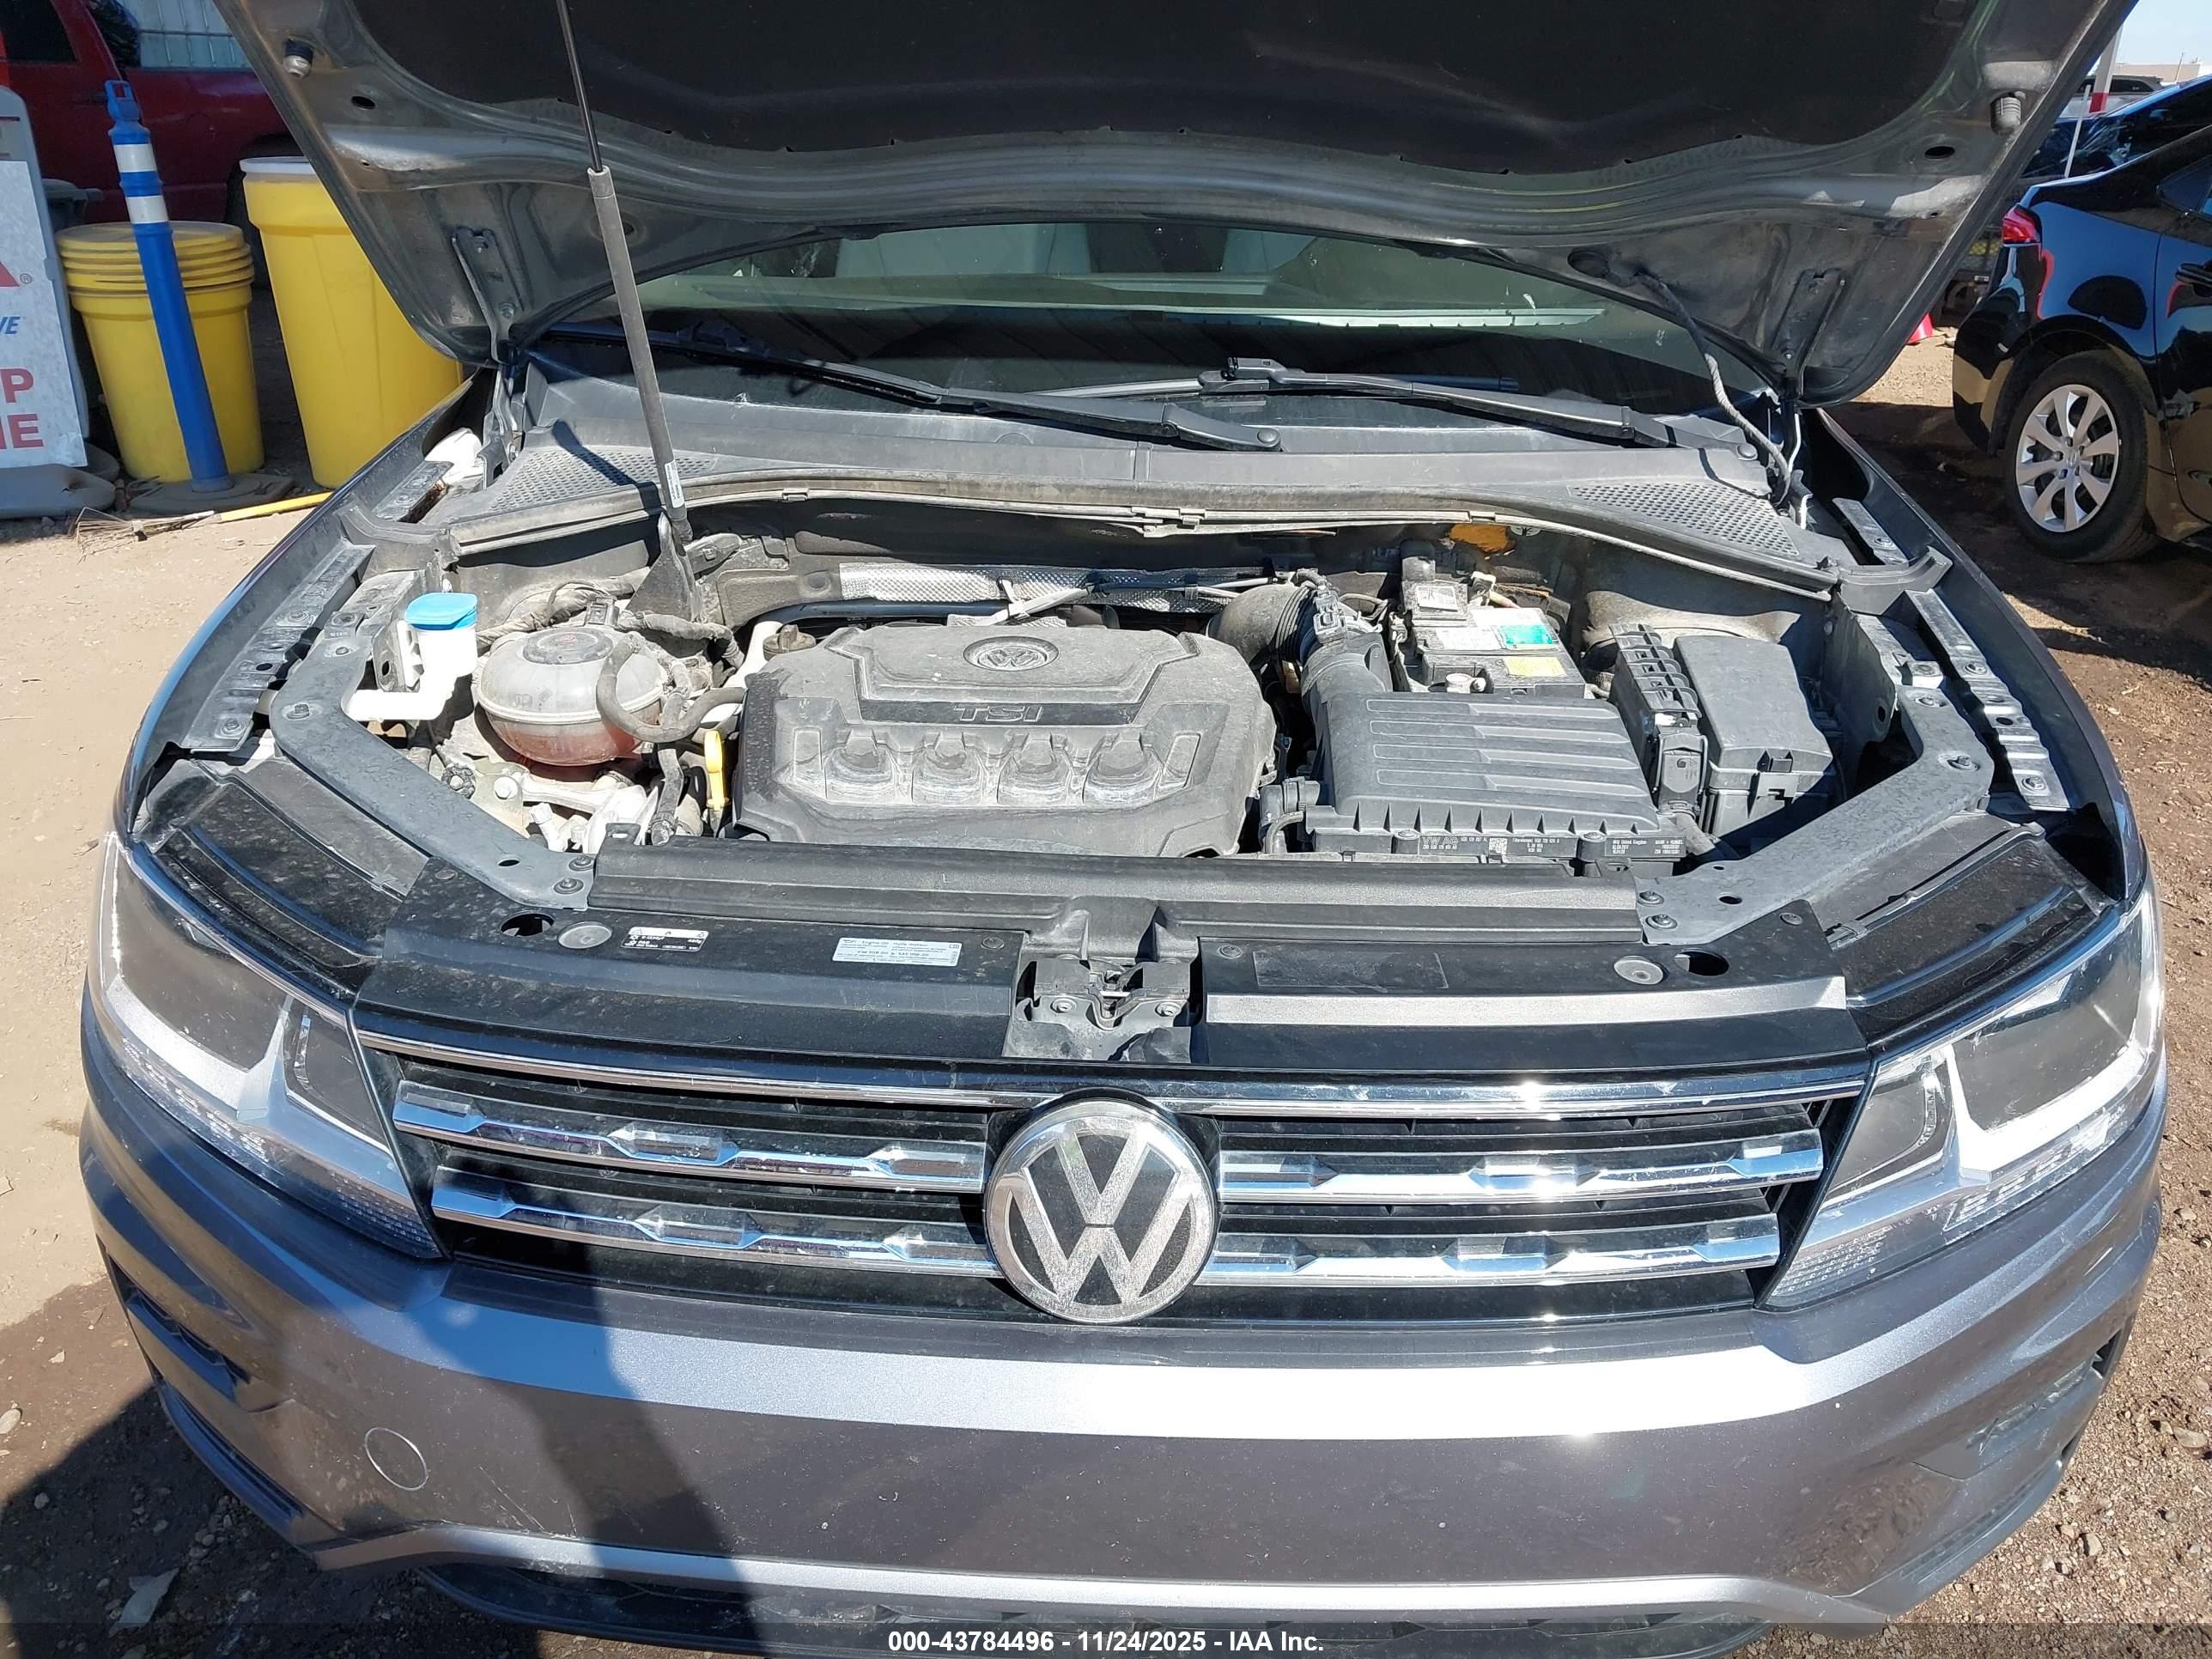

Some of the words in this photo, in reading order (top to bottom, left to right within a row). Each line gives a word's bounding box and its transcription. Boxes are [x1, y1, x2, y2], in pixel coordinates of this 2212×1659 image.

[953, 706, 1042, 721] TSI
[1422, 836, 1441, 845] VW
[1443, 836, 1458, 845] AG
